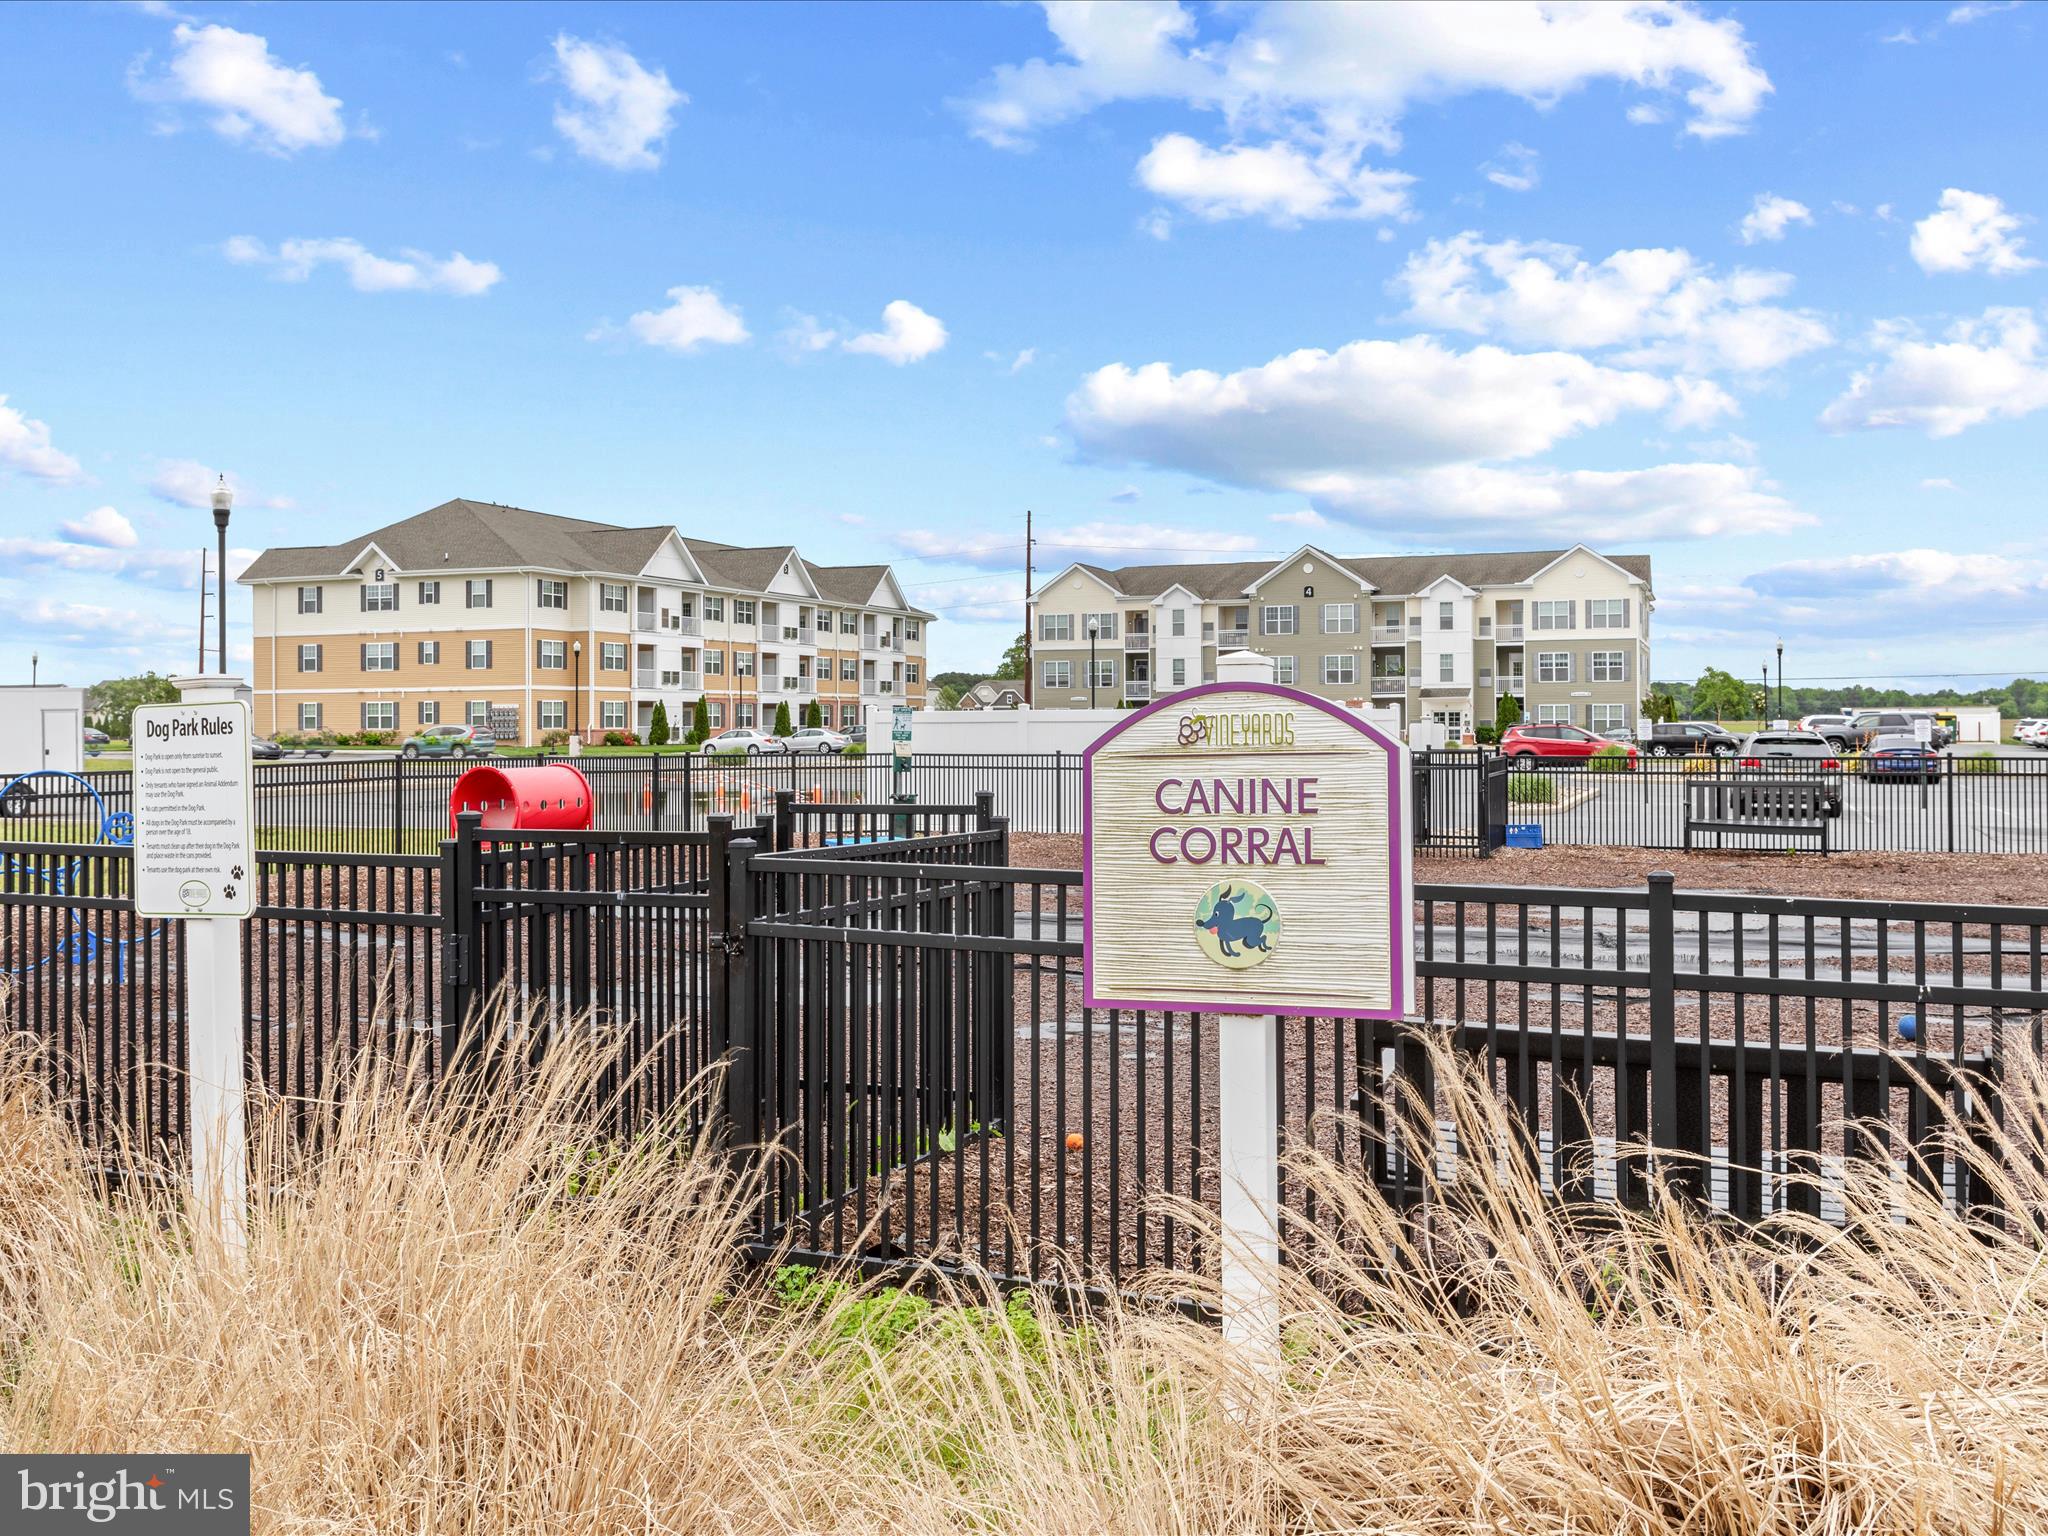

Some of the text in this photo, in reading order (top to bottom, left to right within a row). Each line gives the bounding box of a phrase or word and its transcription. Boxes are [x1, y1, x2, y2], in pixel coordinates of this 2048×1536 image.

[377, 570, 382, 580] 5
[1306, 588, 1312, 596] 4
[147, 716, 233, 742] Dog Park Rules
[1203, 713, 1294, 746] VINEYARDS
[1156, 778, 1318, 814] CANINE
[1149, 827, 1326, 864] CORRAL
